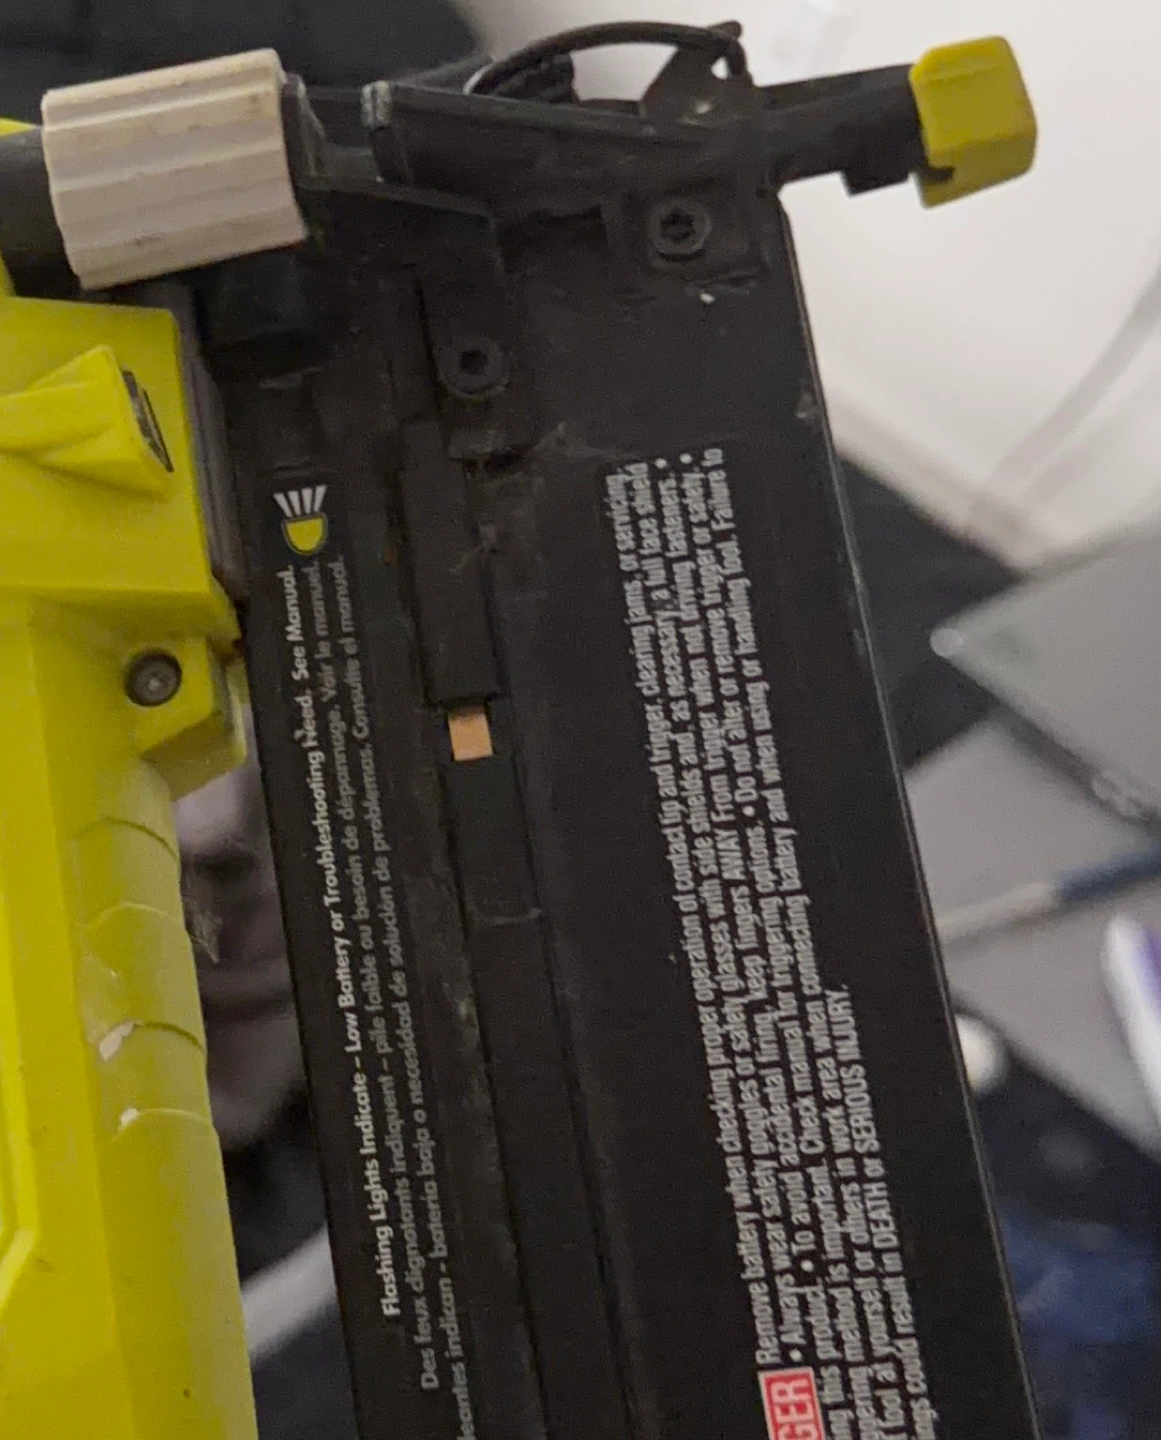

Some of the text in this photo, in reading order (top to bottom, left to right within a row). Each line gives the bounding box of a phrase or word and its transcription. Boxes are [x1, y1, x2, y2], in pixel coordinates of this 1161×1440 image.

[707, 470, 734, 531] Failure
[672, 561, 700, 622] driving
[696, 548, 722, 605] trigger
[679, 624, 704, 654] not
[708, 608, 733, 673] remove
[727, 578, 757, 654] handling
[689, 658, 714, 707] when
[745, 681, 772, 730] using
[699, 712, 726, 770] trigger
[723, 700, 746, 740] alter
[729, 743, 752, 772] not
[755, 735, 781, 784] when
[709, 774, 735, 822] From
[763, 788, 788, 822] and
[715, 830, 745, 880] AWAY
[773, 828, 801, 891] battery
[625, 462, 806, 1345] Always wear safety goggles safety glasses with side shields full face shield
[730, 885, 759, 950] fingers
[278, 565, 401, 1316] Flashing Lights Indicate Low Battery or Troubleshooting See Manual.
[619, 554, 780, 1364] Remove battery when checking proper operation of contact tip and clearing or
[759, 896, 793, 987] triggering
[785, 894, 822, 996] connecting
[742, 954, 768, 1001] keep
[776, 991, 798, 1016] for
[805, 1000, 831, 1052] when
[779, 1020, 812, 1092] manual
[817, 1057, 841, 1100] area
[760, 1068, 799, 1167] accidental
[793, 1095, 824, 1154] Check
[823, 1105, 851, 1153] work
[841, 1064, 879, 1153] SERIOUS
[779, 1171, 811, 1225] avoid
[840, 1182, 868, 1244] others
[863, 1182, 897, 1248] DEATH
[828, 1287, 863, 1362] method
[854, 1276, 894, 1357] yourself
[882, 1275, 914, 1334] result
[817, 1366, 844, 1404] this
[893, 1337, 925, 1394] could
[875, 1388, 904, 1428] tool
